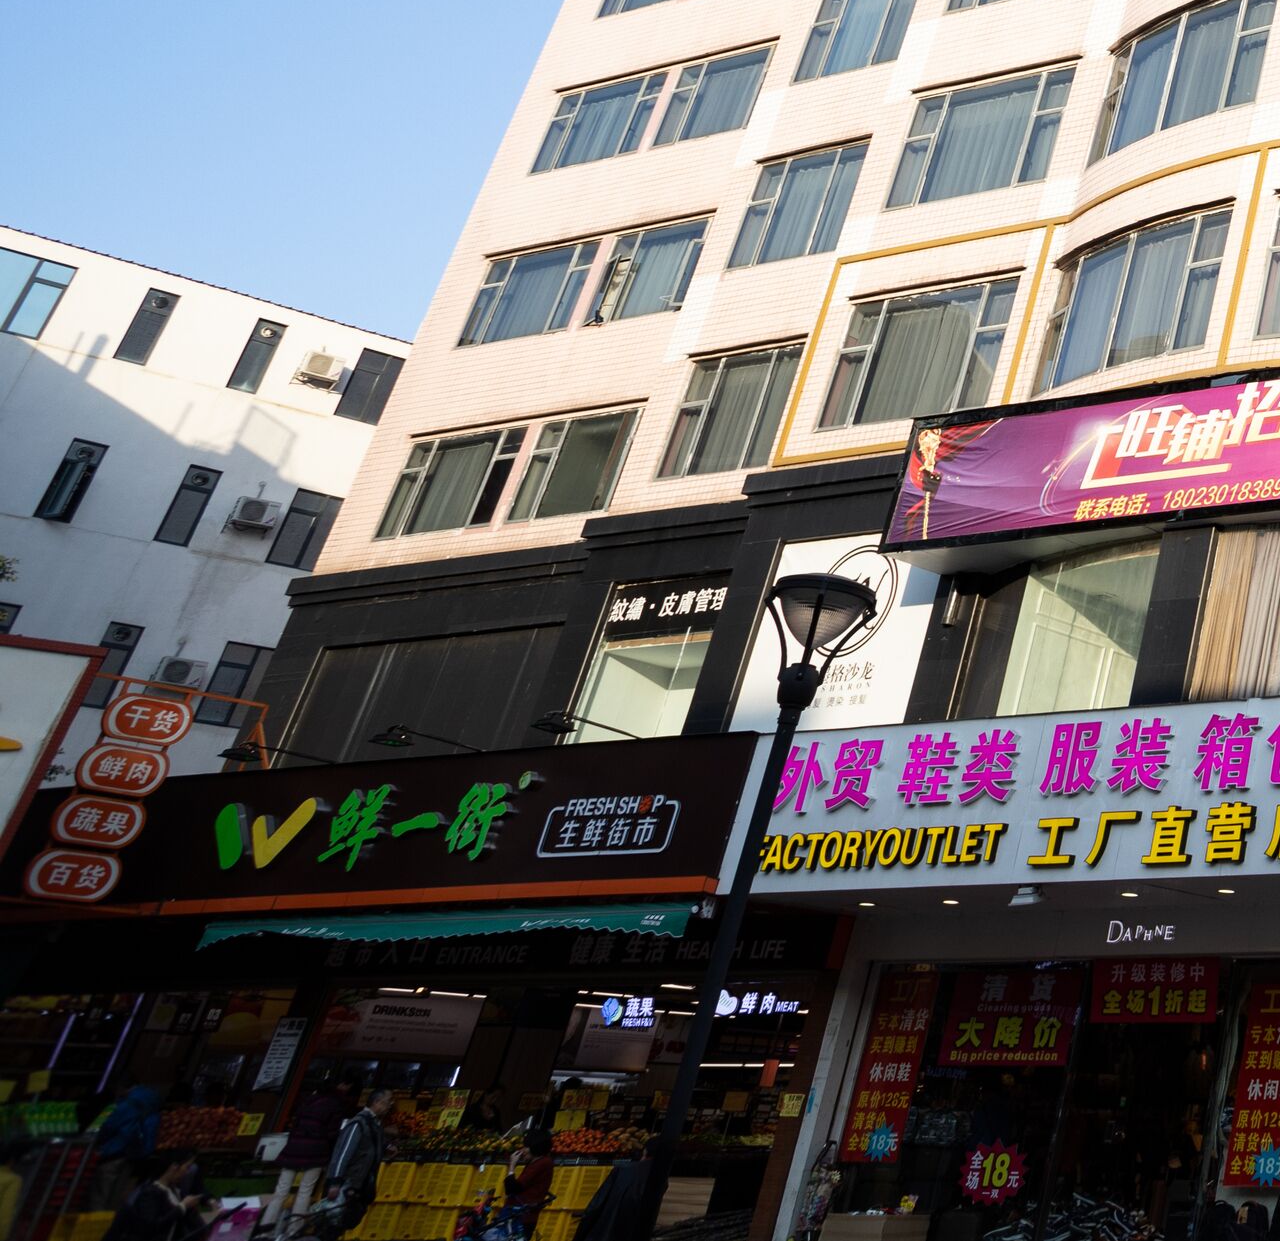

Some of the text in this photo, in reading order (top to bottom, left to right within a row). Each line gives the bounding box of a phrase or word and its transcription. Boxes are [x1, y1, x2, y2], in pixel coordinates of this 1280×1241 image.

[125, 705, 180, 734] 干货
[95, 755, 153, 785] 鲜肉
[773, 738, 885, 814] 外贸
[897, 730, 1021, 806] 鞋类
[1040, 720, 1172, 796] 服装
[564, 796, 618, 817] FRESH
[69, 807, 131, 836] 蔬果
[317, 782, 508, 872] 鲜一街
[554, 817, 659, 848] 生鲜街市
[47, 862, 106, 890] 百货
[1106, 920, 1176, 943] DAPHNE
[436, 944, 531, 966] ENTRANCE
[569, 935, 788, 965] 健康 生活 HEAH LIFE
[1111, 962, 1206, 984] 升级装修中
[625, 997, 654, 1017] 蔬果
[739, 992, 799, 1015] 鲜肉 MEAT
[1103, 985, 1208, 1016] 全场1折起
[955, 1016, 1063, 1049] 大降价
[950, 1050, 1058, 1062] Big price reduction
[869, 1061, 912, 1083] 休闲鞋
[1232, 1131, 1274, 1153] 清货价
